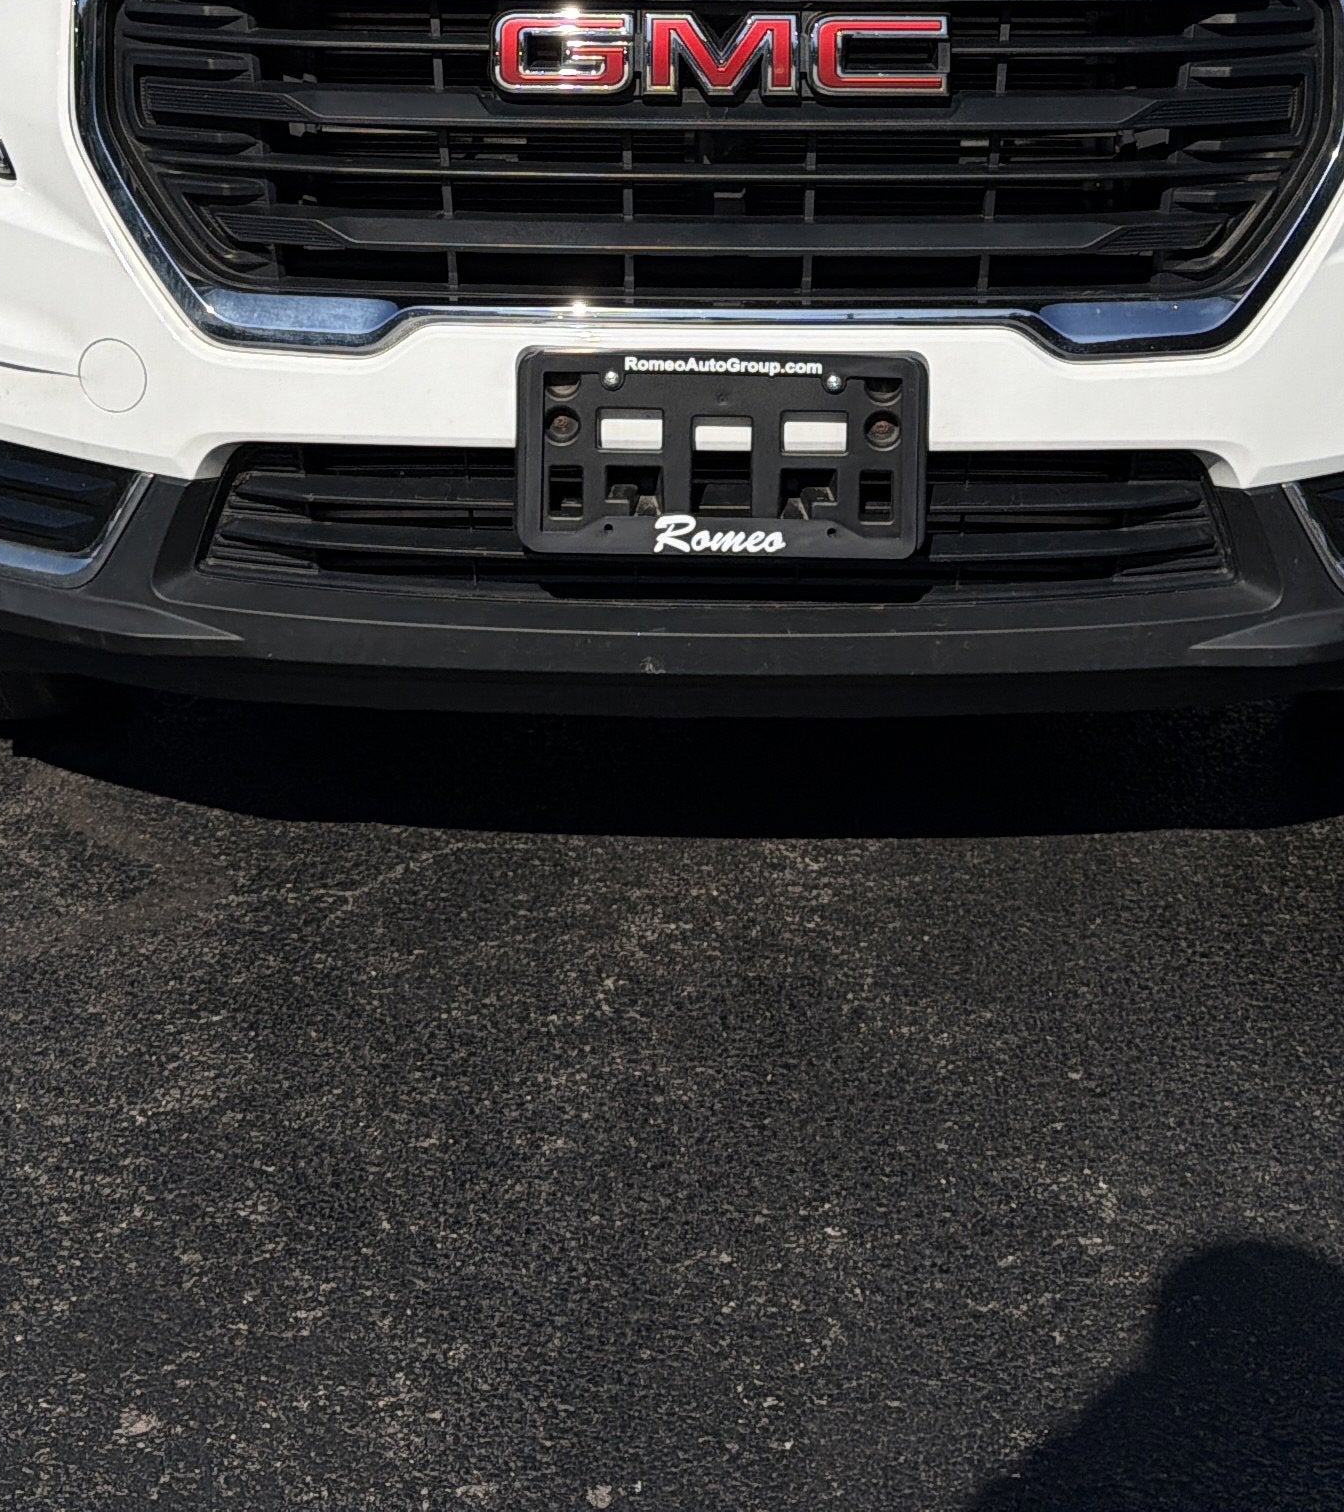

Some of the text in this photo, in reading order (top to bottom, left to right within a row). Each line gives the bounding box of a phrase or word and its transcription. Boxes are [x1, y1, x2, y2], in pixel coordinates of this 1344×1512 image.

[494, 9, 950, 96] GMC
[624, 356, 823, 376] RomeoAutoGroup.com
[654, 514, 786, 554] Romeo
